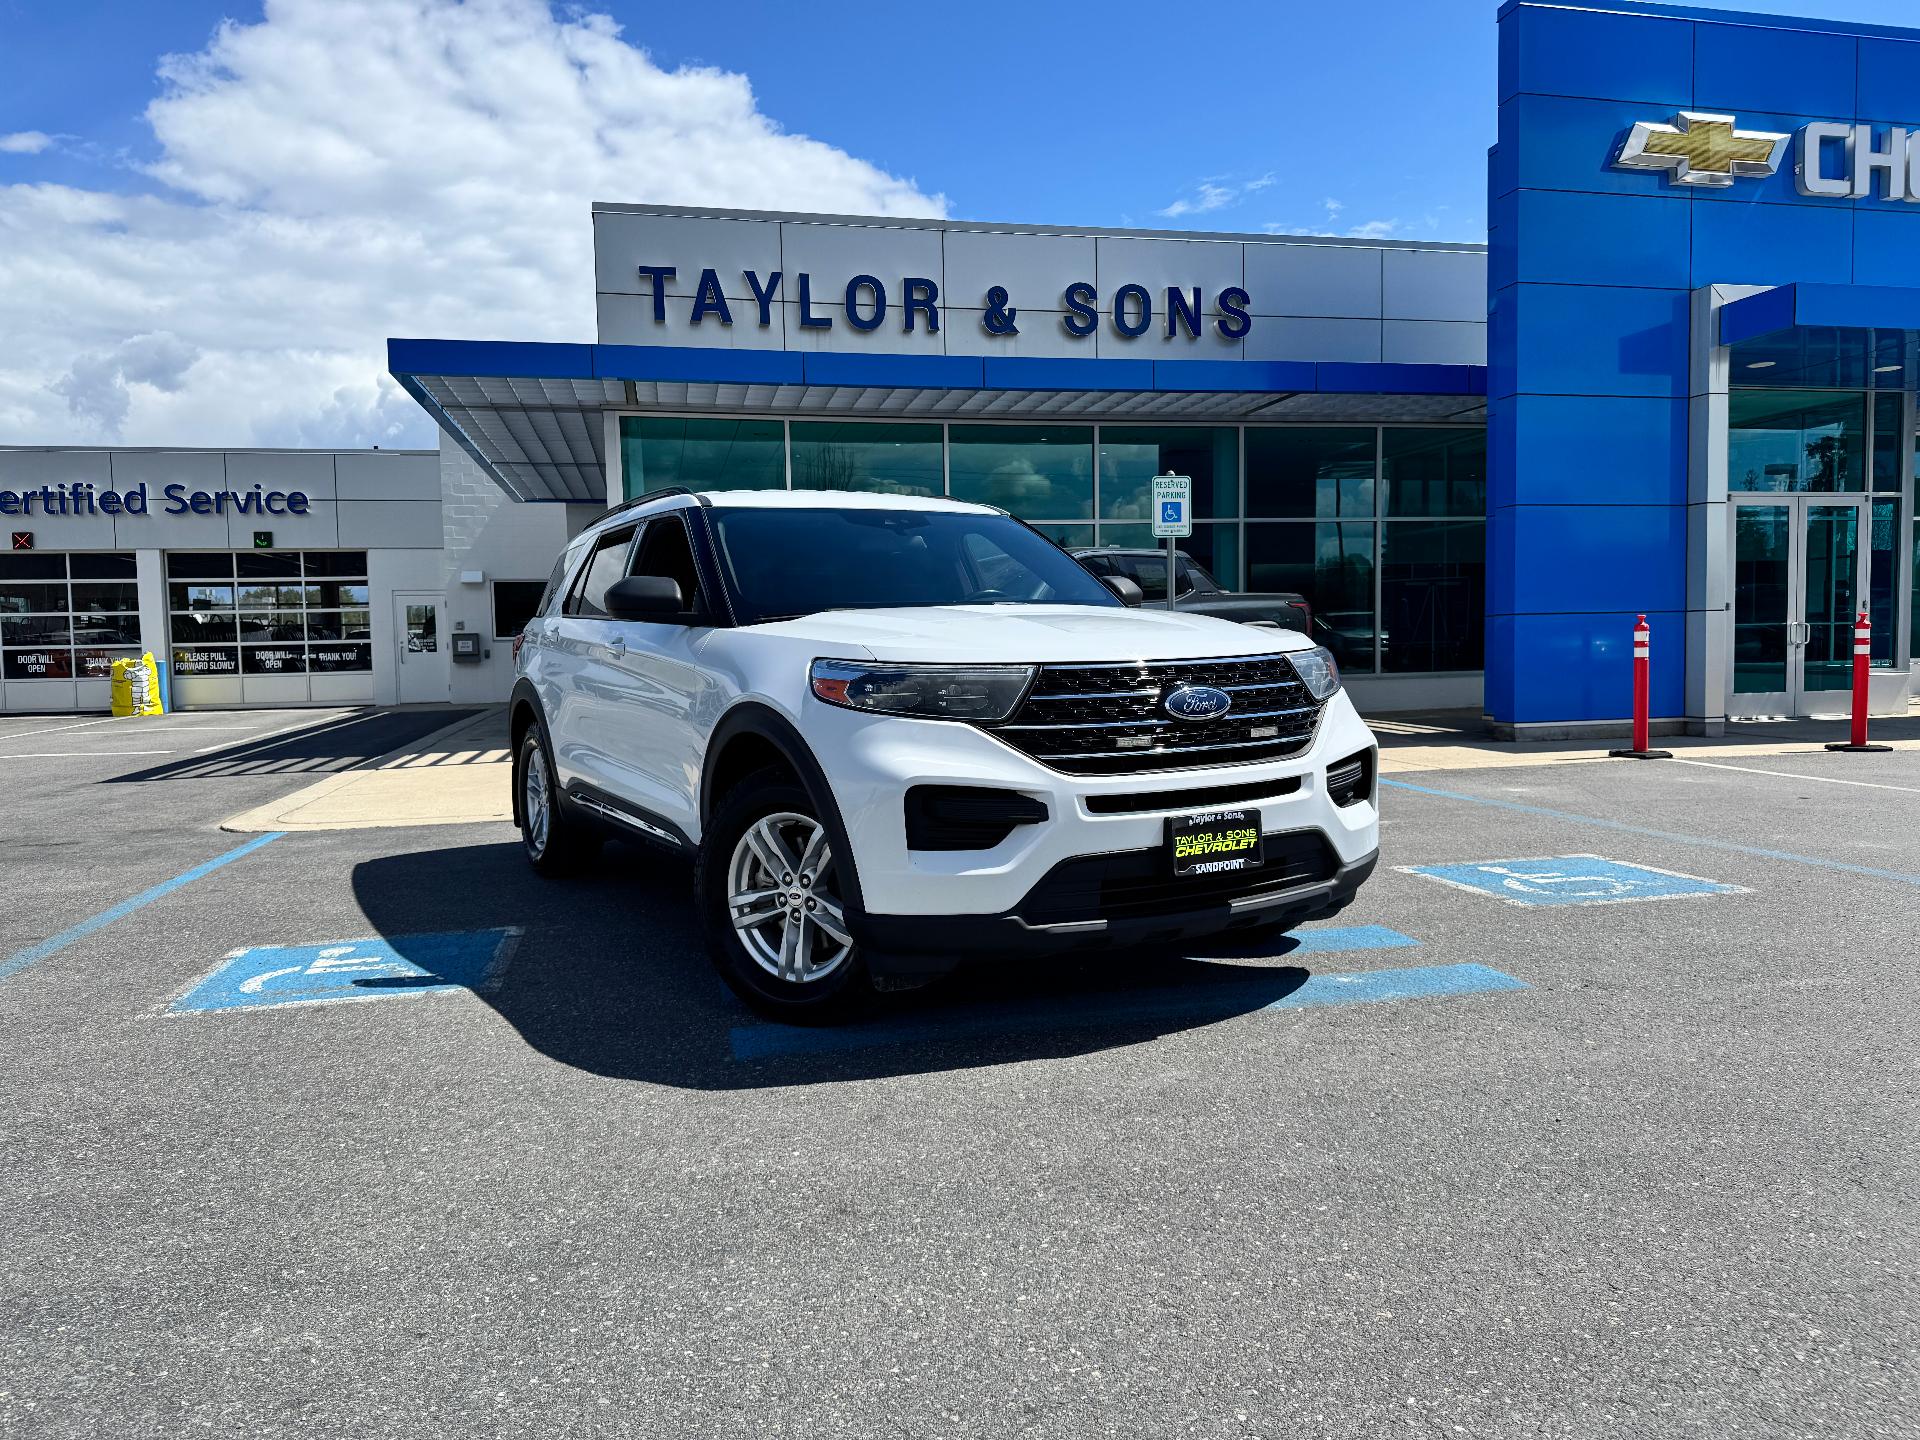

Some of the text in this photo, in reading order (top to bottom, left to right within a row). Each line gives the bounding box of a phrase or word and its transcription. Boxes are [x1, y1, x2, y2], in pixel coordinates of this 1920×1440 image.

[1795, 121, 1920, 200] CH
[638, 265, 1252, 340] TAYLOR & SONS
[1155, 481, 1188, 489] RESERVED
[164, 483, 310, 515] Service
[1156, 491, 1186, 499] PARKING
[17, 655, 37, 664] DOOR
[37, 654, 55, 664] WILL
[184, 652, 227, 661] PLEASE PULL
[255, 651, 290, 660] DOOR WILL
[319, 652, 340, 661] THANK
[28, 664, 46, 673] OPEN
[175, 660, 235, 671] FORWARD SLOWLY
[265, 660, 282, 669] OPEN
[1183, 693, 1218, 713] Ford
[1192, 811, 1242, 826] Taylor & Sons
[1175, 828, 1257, 846] TAYLOR & SONS
[1175, 838, 1258, 858] CHEVROLET
[1195, 858, 1245, 875] SANDPOINT
